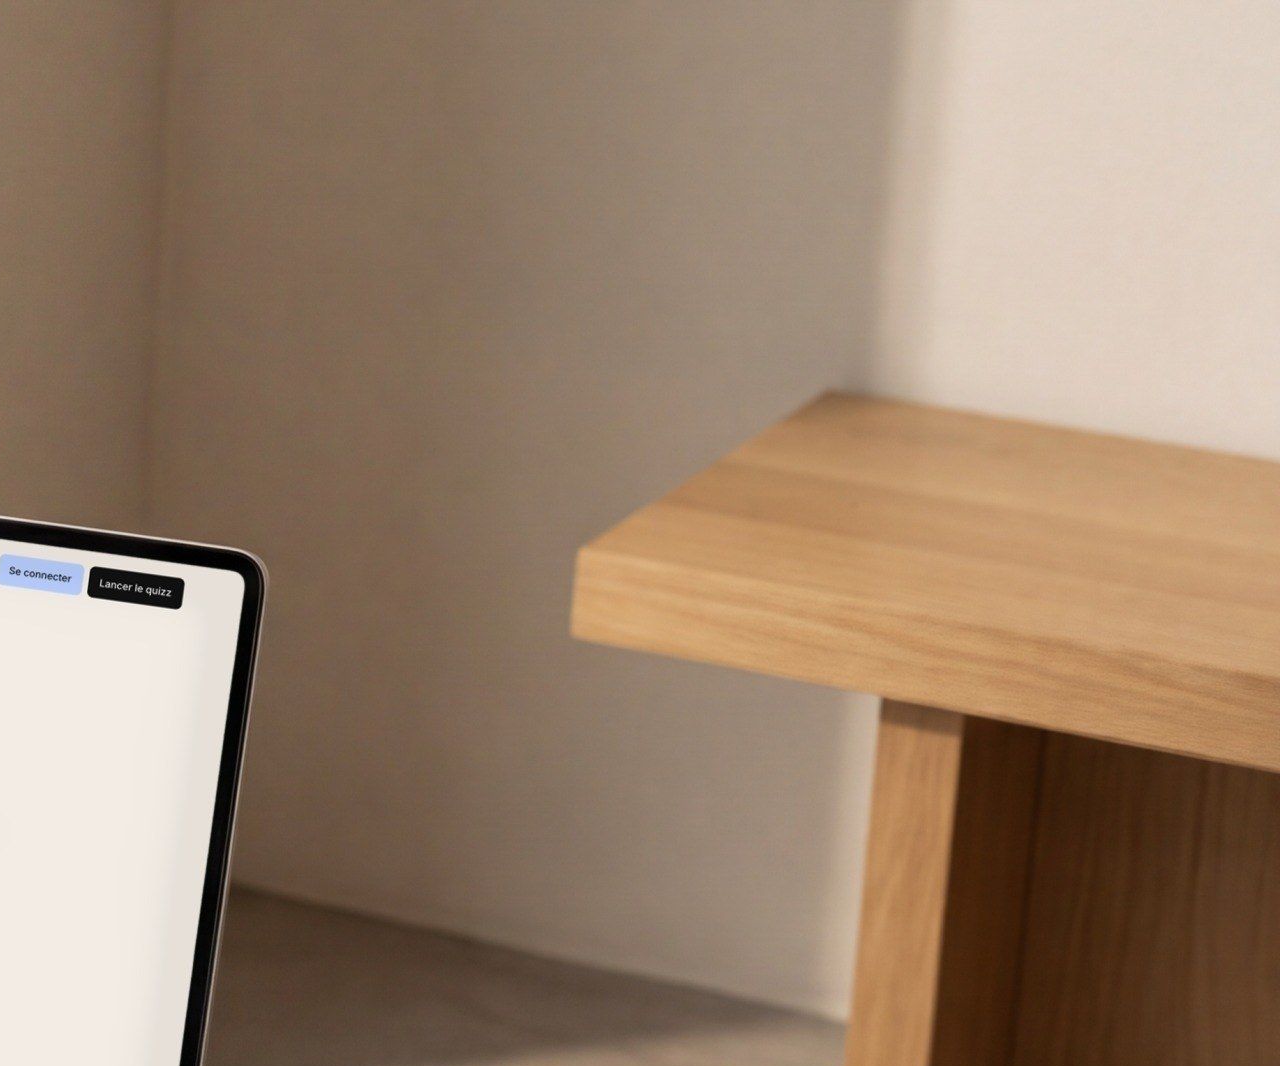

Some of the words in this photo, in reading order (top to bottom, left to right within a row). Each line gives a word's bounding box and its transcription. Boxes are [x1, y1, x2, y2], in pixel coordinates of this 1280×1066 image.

[8, 566, 22, 576] Se
[23, 570, 72, 583] connecter
[99, 578, 133, 591] Lancer
[134, 583, 144, 593] le
[145, 586, 172, 597] quizz
